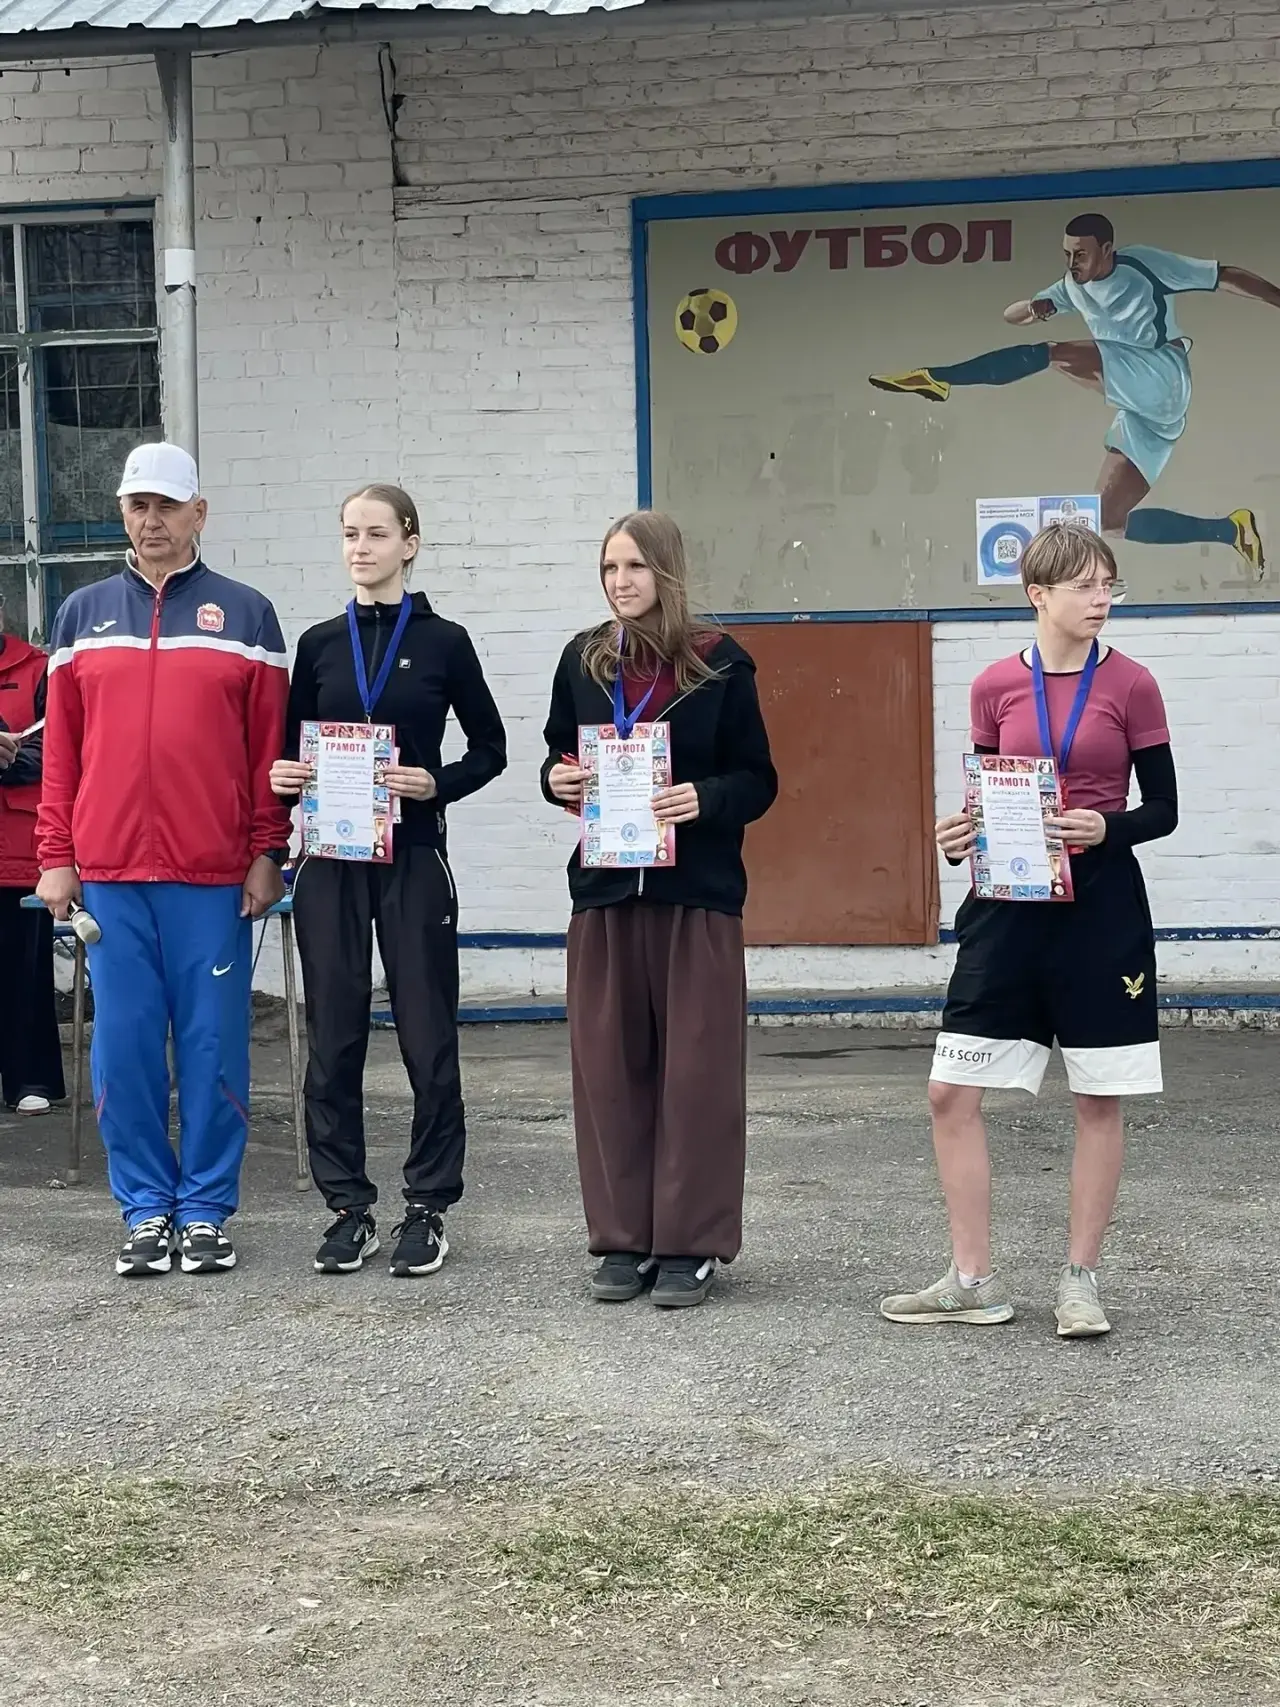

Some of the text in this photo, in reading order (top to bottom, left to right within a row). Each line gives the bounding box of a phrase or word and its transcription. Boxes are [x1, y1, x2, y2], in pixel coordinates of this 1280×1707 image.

[715, 219, 1012, 275] ФУТБОЛ
[326, 742, 366, 753] ГРАМОТА
[605, 744, 646, 754] ГРАМОТА
[988, 776, 1031, 787] ГРАМОТА
[957, 1049, 993, 1063] SCOTT
